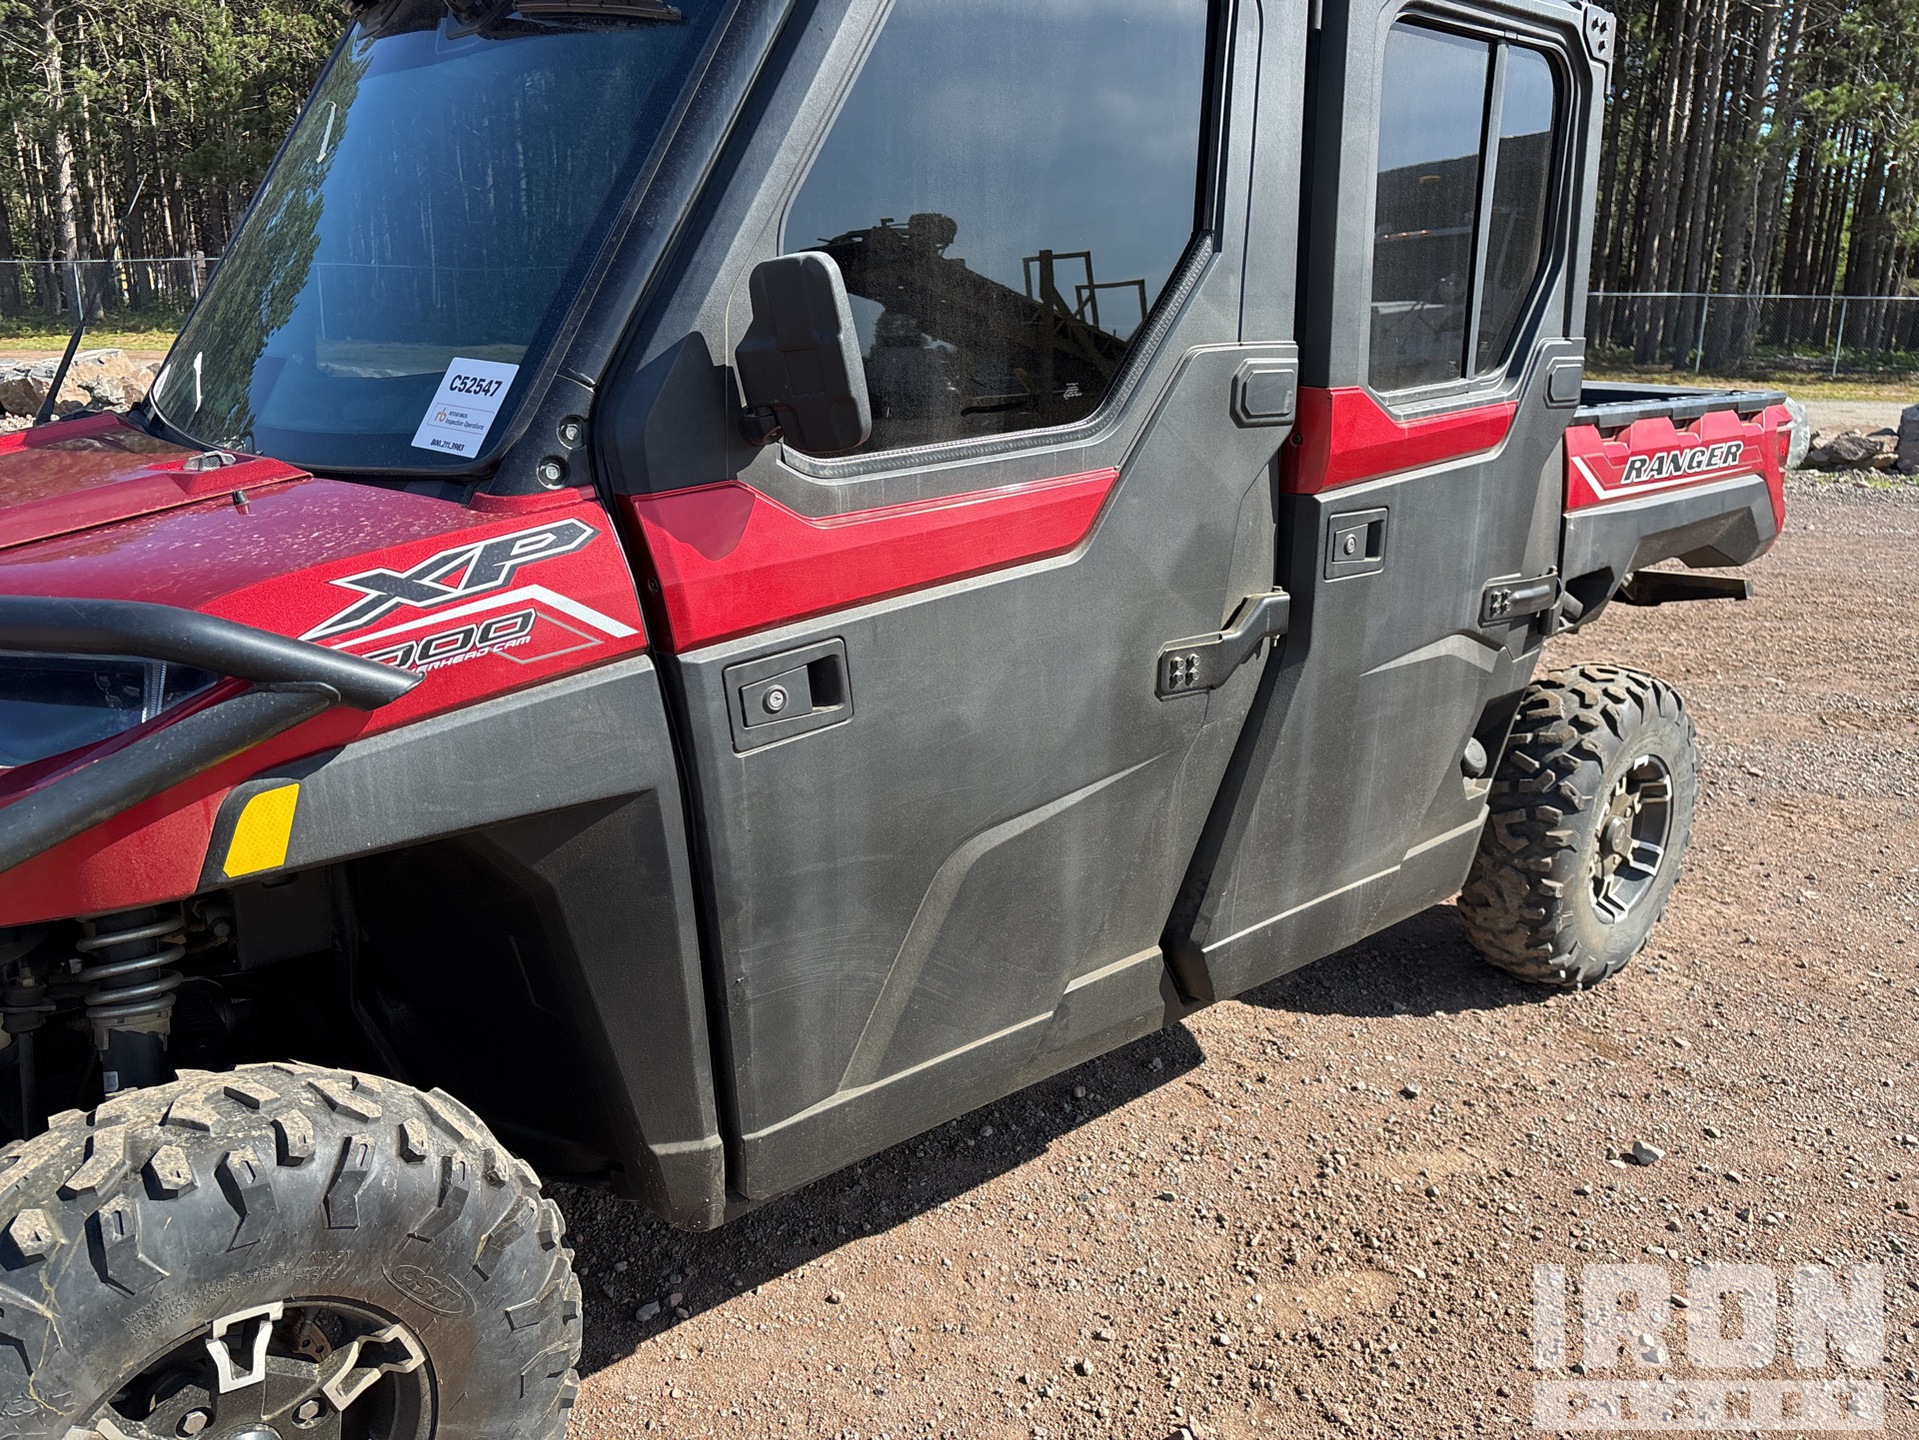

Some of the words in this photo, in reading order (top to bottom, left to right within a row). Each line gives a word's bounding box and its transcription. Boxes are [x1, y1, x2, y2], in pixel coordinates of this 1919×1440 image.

[449, 374, 503, 397] C52547
[1620, 440, 1744, 485] RANGER
[297, 518, 601, 642] XP
[410, 648, 490, 674] ERHEAD
[492, 634, 532, 653] CAM
